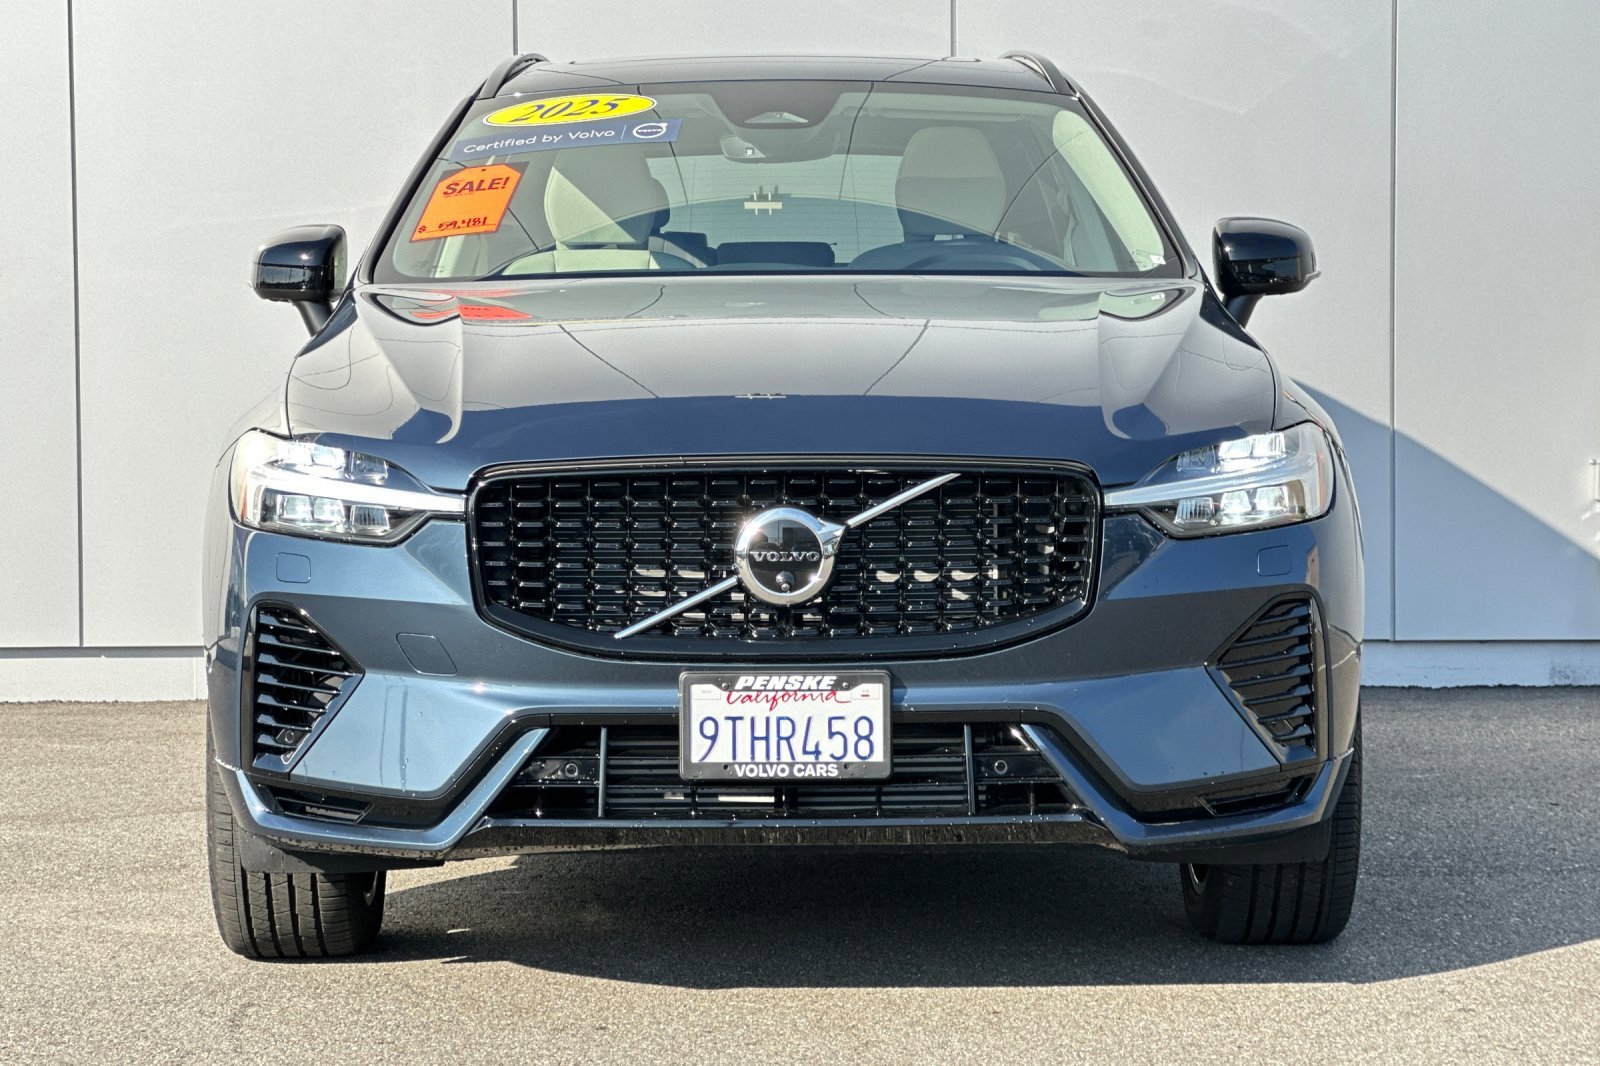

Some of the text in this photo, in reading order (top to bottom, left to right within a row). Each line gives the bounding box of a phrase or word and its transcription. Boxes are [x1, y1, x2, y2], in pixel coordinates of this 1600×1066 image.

[509, 98, 629, 123] 2025
[463, 129, 615, 153] Certified by Volvo
[443, 176, 510, 196] SALE!
[750, 551, 820, 562] VOLVO
[734, 676, 837, 690] PENSKE
[726, 690, 852, 711] California
[698, 716, 875, 762] 9THR458
[734, 764, 839, 777] VOLVO CARS
